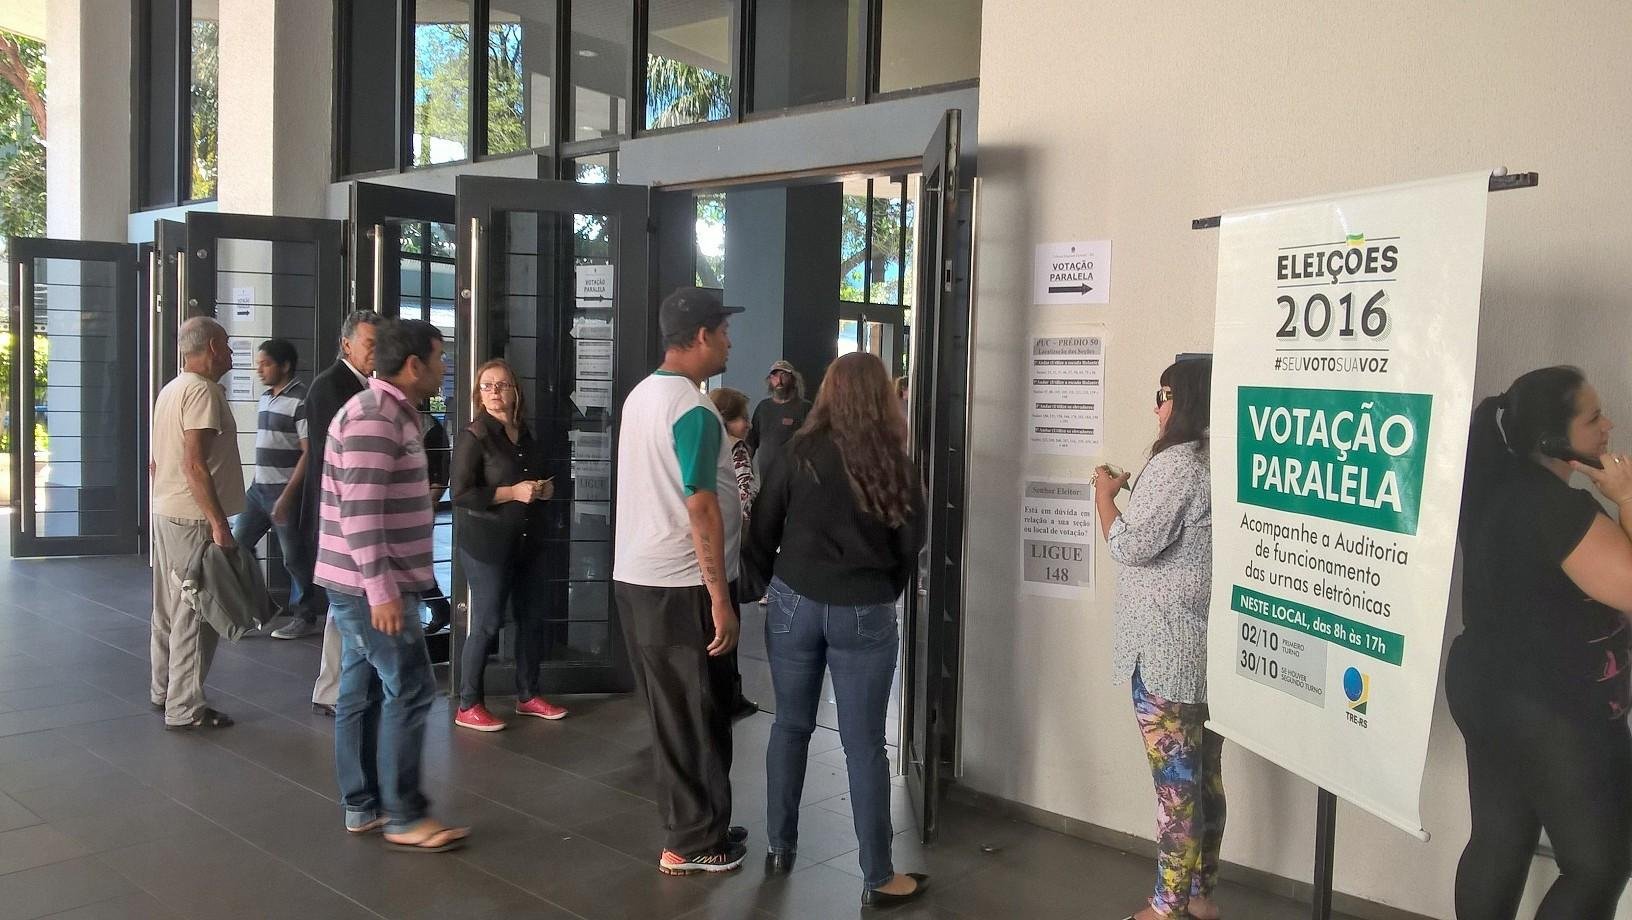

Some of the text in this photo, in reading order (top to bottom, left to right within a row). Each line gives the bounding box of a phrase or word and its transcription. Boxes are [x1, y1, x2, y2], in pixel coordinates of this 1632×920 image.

[1052, 260, 1094, 271] VOTAÇÃO
[1049, 272, 1094, 282] PARALELA
[1276, 289, 1389, 338] 2016
[1058, 337, 1088, 347] PRÉDIO
[1274, 357, 1389, 373] #SEUVOTOSUAVOZ
[1248, 401, 1414, 461] VOTAÇÃO
[1252, 454, 1402, 513] PARALELA
[1054, 508, 1077, 516] dúvida
[1033, 525, 1049, 534] local
[1050, 527, 1058, 535] de
[1240, 512, 1409, 565] Acompanhe a Auditoria
[1031, 544, 1083, 562] LIGUE
[1255, 539, 1381, 587] de funcionamento
[1045, 566, 1069, 582] 148
[1245, 560, 1392, 618] das urnas eletrônicas
[1240, 594, 1386, 654] NESTE LOCAL, das 8h às 17h
[1241, 622, 1279, 652] 02/10
[1281, 638, 1305, 652] PRIMEIRO
[1281, 646, 1301, 658] TURNO
[1240, 649, 1278, 679] 30/10
[1281, 674, 1323, 696] SEGUNDO TURNO
[1345, 710, 1369, 729] TRE-RS
